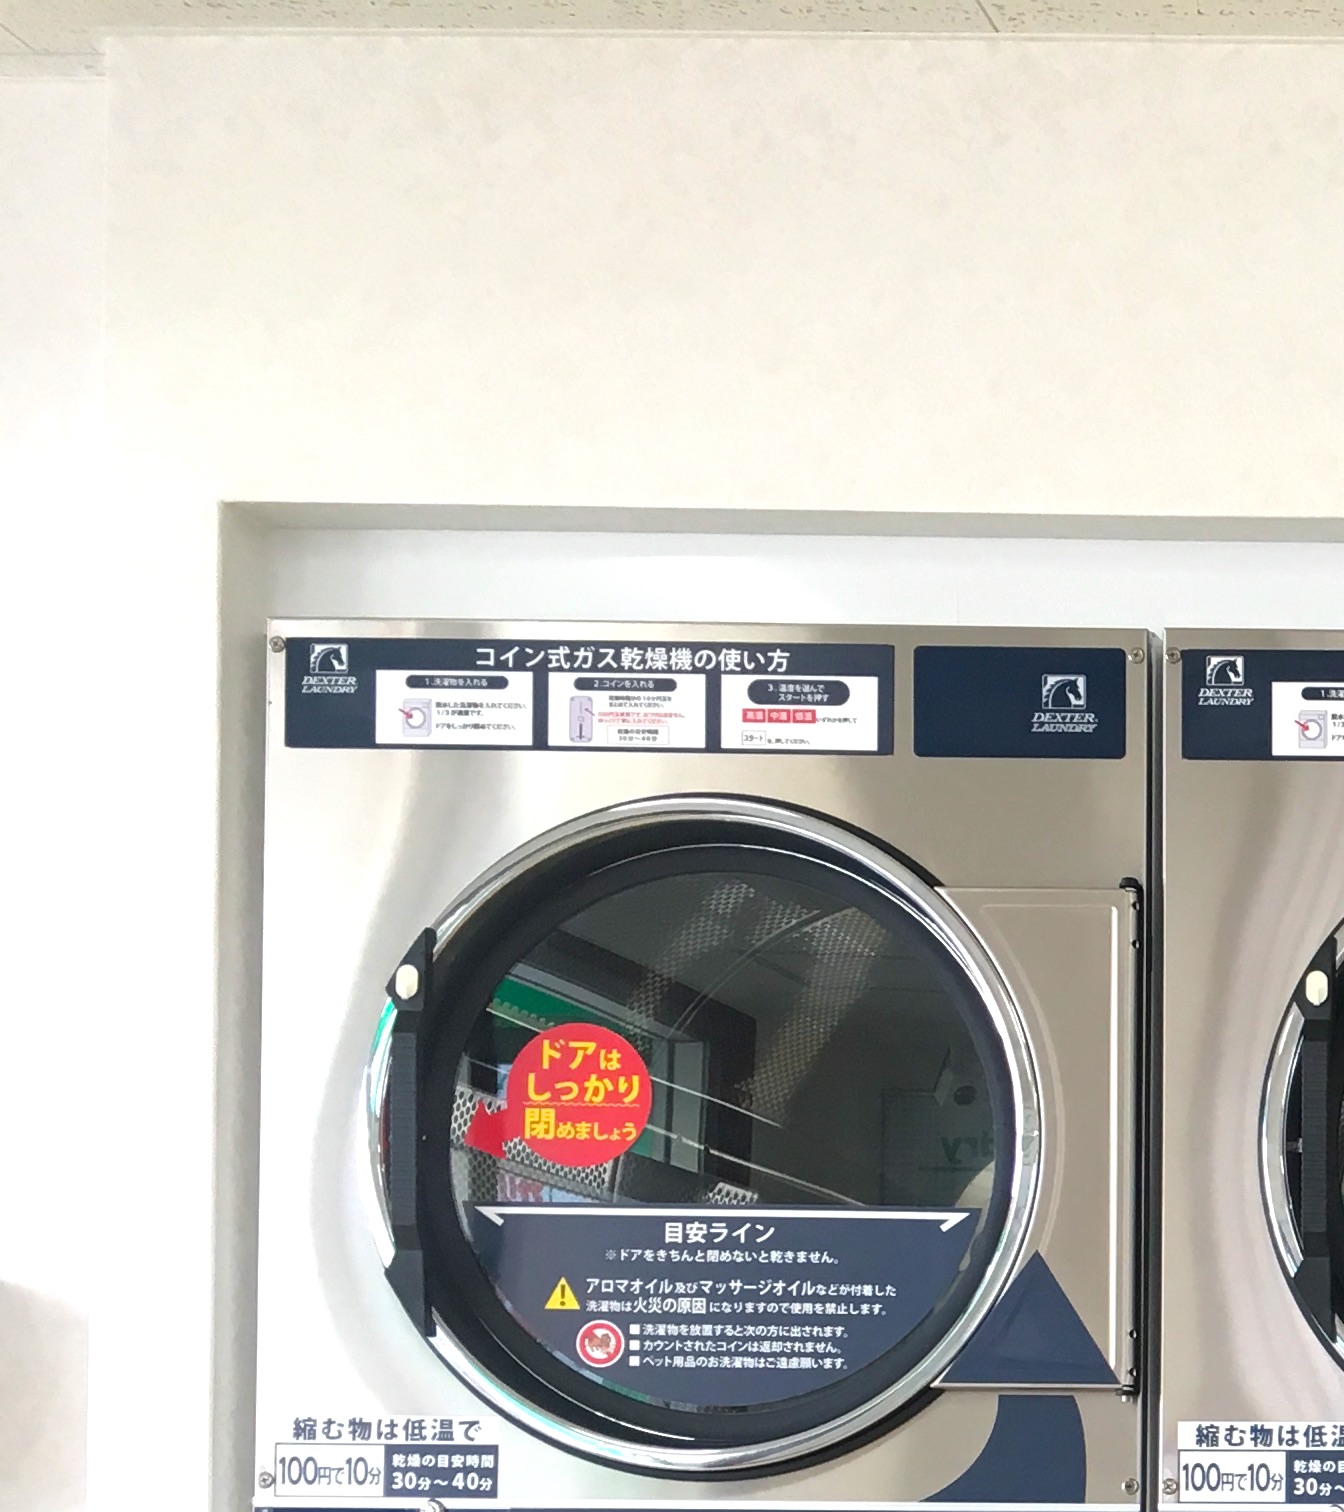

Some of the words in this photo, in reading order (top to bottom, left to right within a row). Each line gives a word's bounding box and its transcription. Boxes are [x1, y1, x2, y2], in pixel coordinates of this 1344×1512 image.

[475, 646, 790, 672] コイン式ガス乾燥機の使い方
[302, 676, 357, 686] DEXTER
[302, 685, 358, 694] LAUNDRY
[1198, 688, 1252, 697] DEXTER
[1198, 698, 1253, 706] LAUNDRY
[541, 1039, 621, 1070] ドアは
[527, 1074, 639, 1104] しっかり
[524, 1108, 637, 1141] 閉めましょう
[665, 1222, 775, 1244] 目安ライン
[585, 1277, 897, 1297] アロマオイル及びマッサージオイルなどが付着した
[293, 1418, 481, 1443] 縮む物は低温で
[278, 1455, 381, 1487] 100円で10分
[392, 1453, 494, 1469] 乾燥の目安時間
[392, 1472, 493, 1492] 30分～40分
[1182, 1462, 1284, 1493] 100円で10分
